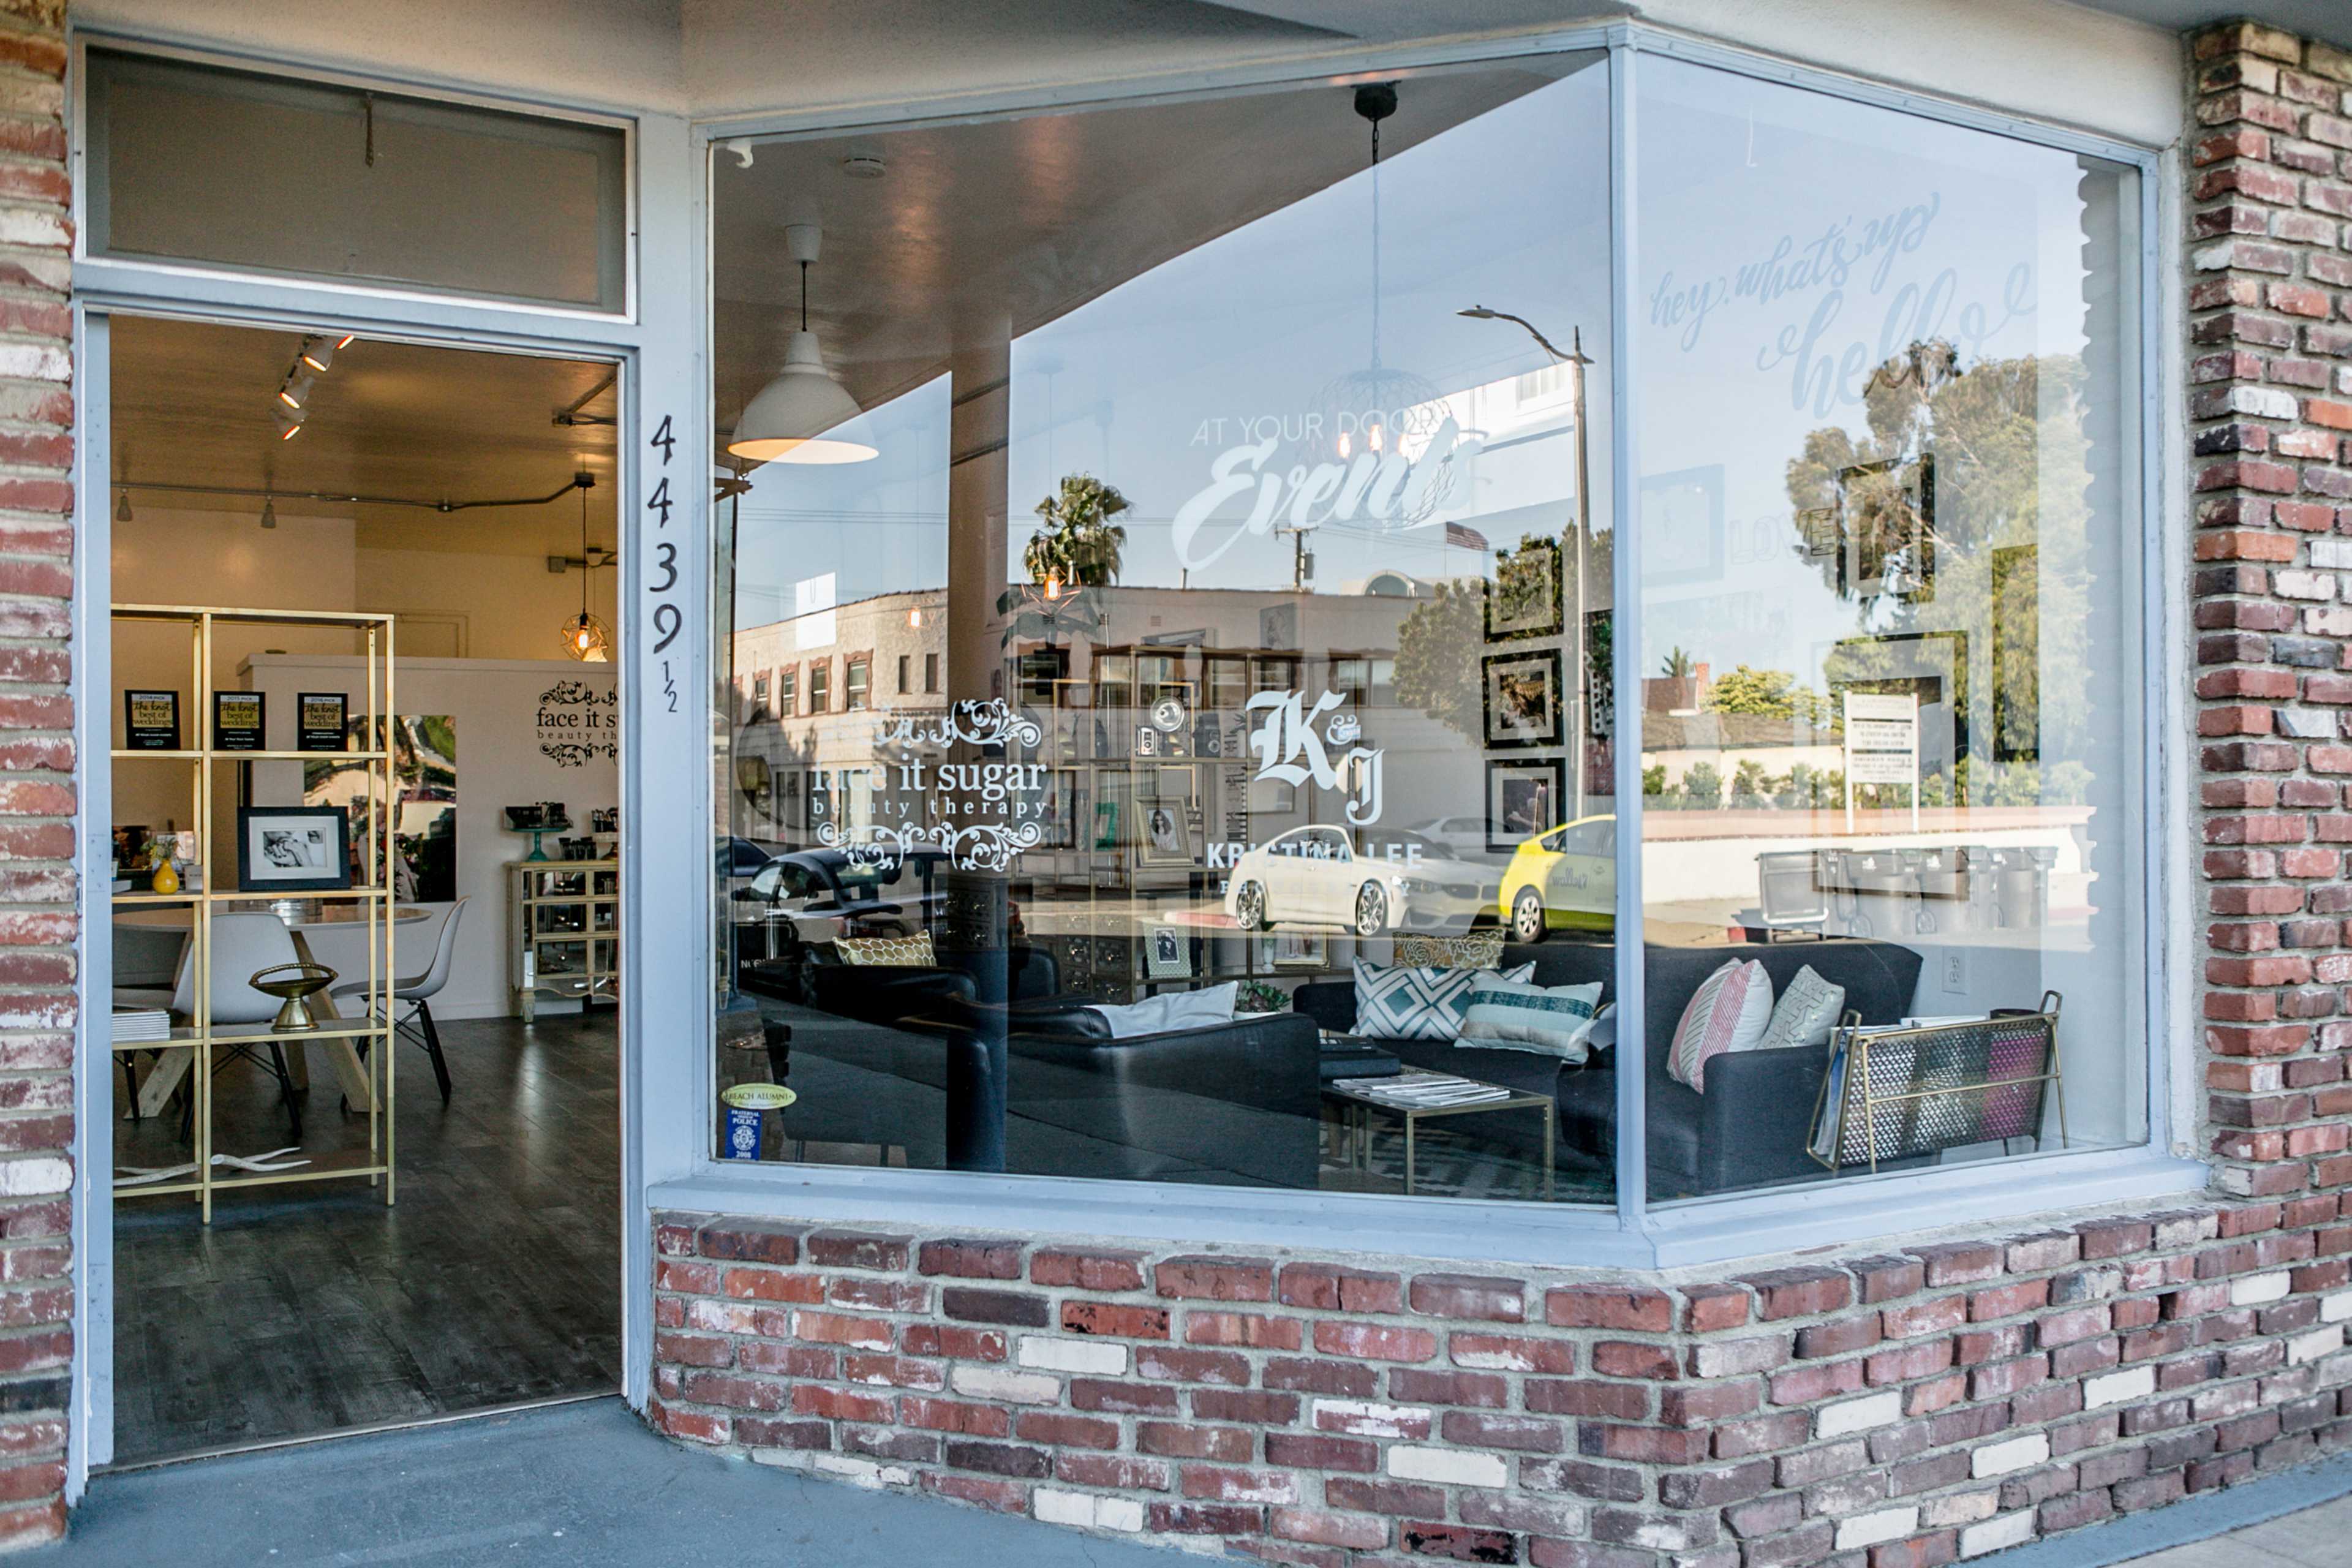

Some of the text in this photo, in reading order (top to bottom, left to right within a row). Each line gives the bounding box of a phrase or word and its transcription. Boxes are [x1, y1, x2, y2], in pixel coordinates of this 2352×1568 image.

[1862, 191, 1941, 295] up
[1190, 418, 1228, 446] AT
[1239, 413, 1324, 444] YOUR
[133, 700, 172, 711] the knot
[221, 701, 258, 712] the knot
[304, 703, 341, 713] the knot
[133, 717, 173, 726] weddings
[221, 718, 259, 728] weddings
[537, 707, 618, 728] face it s
[304, 719, 341, 729] weddings
[537, 730, 592, 742] beauty
[812, 753, 1047, 801] face it sugar
[812, 797, 1048, 819] beauty therapy
[733, 1117, 758, 1126] POLICE
